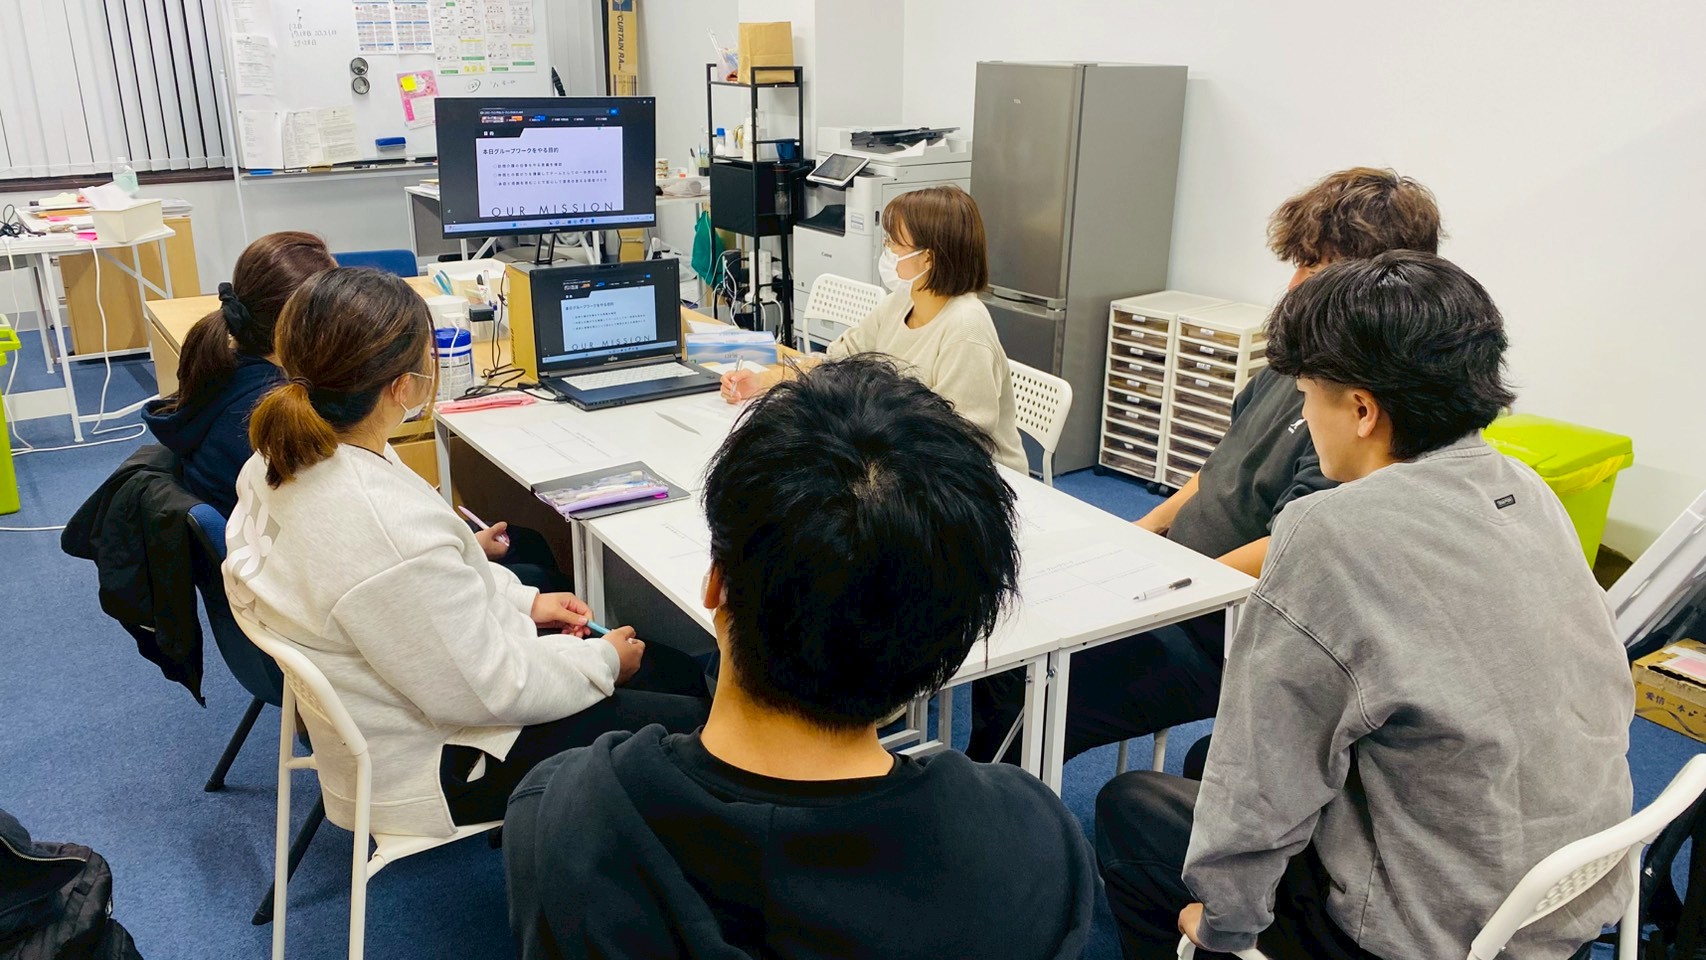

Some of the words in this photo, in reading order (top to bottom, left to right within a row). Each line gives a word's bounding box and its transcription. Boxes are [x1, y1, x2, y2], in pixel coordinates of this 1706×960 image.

[617, 14, 625, 51] CURTAIN
[483, 147, 559, 155] 本日グループワークをやる目的
[491, 206, 526, 217] OUR
[539, 202, 613, 214] MISSION
[571, 341, 594, 351] OUR
[602, 335, 650, 347] MISSION
